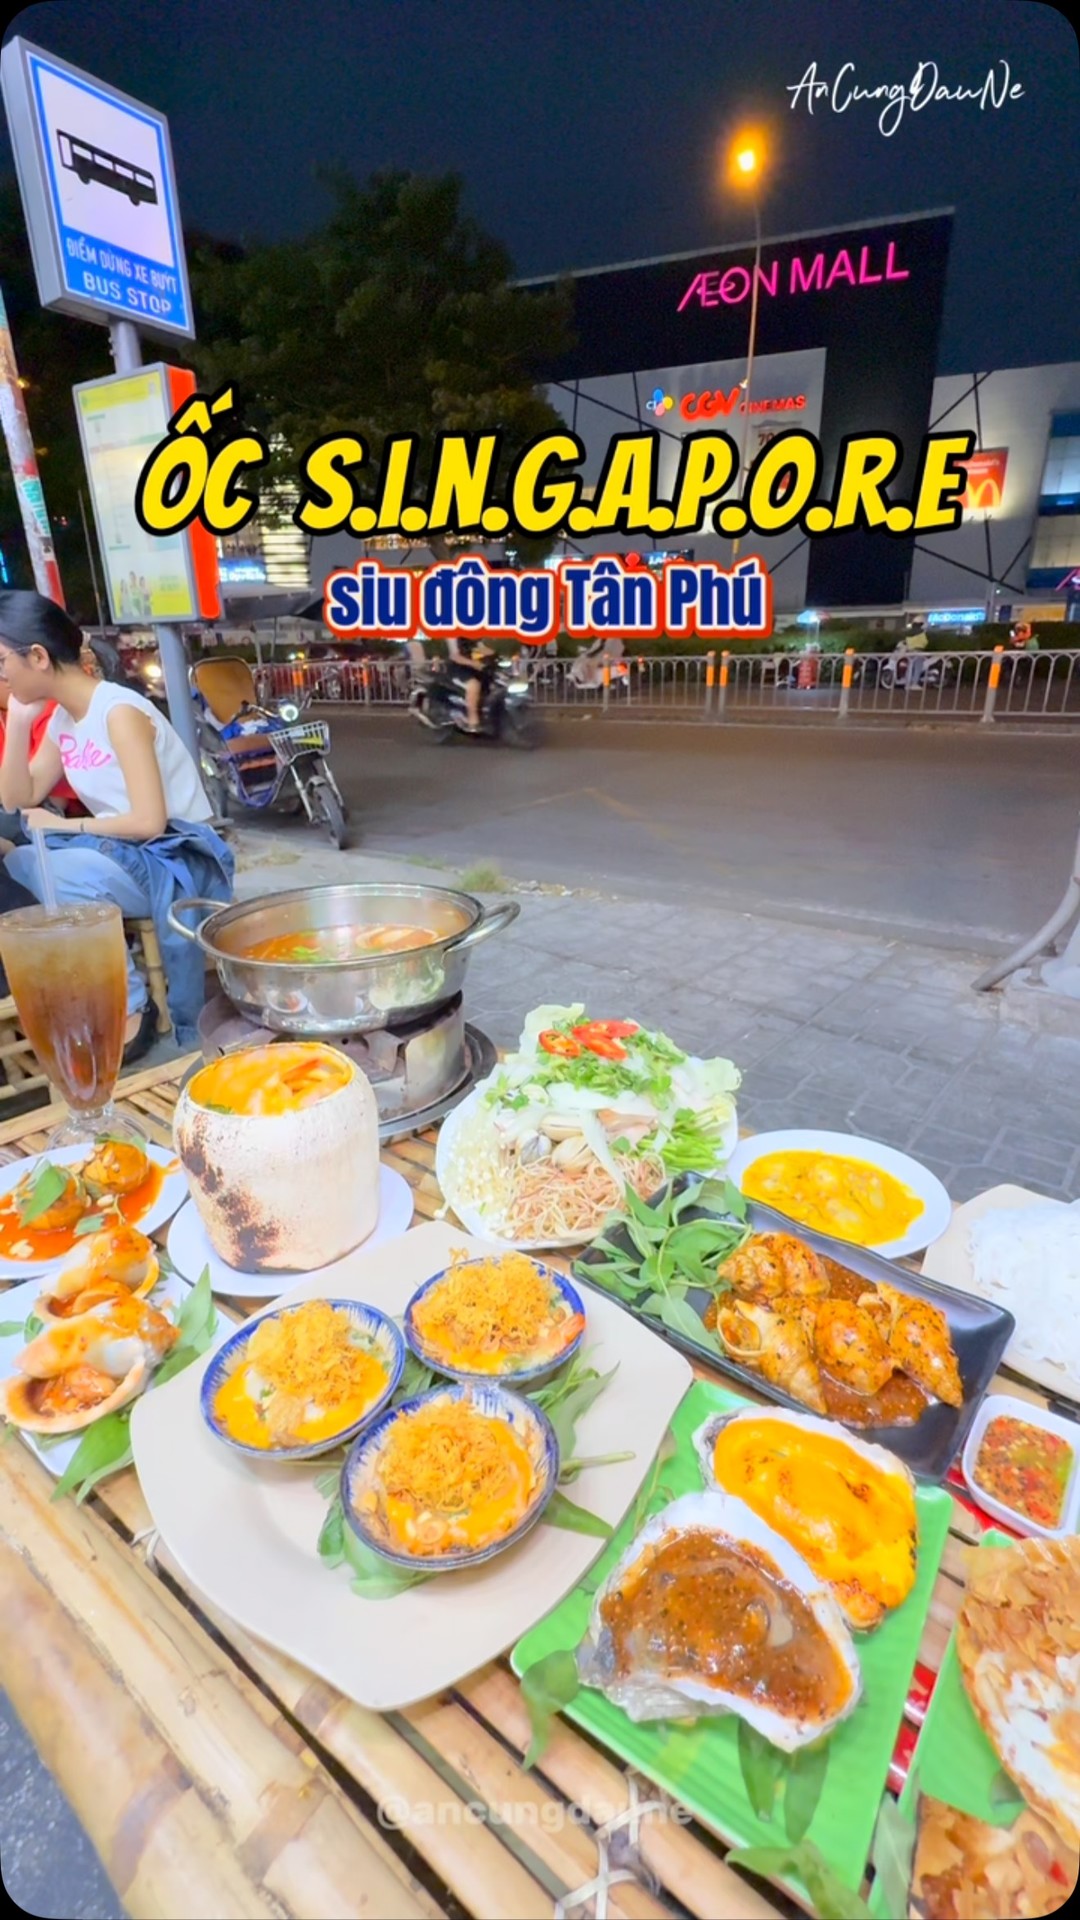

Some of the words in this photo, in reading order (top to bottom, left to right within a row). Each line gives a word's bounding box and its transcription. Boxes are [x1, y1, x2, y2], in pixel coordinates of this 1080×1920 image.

[66, 235, 98, 266] ĐIỂM
[99, 247, 132, 279] DỪNG
[133, 262, 149, 285] XE
[790, 241, 910, 295] MALL
[83, 270, 121, 300] BUS
[127, 286, 172, 314] STOP
[680, 387, 741, 422] CGV
[739, 395, 807, 416] CINEMAS
